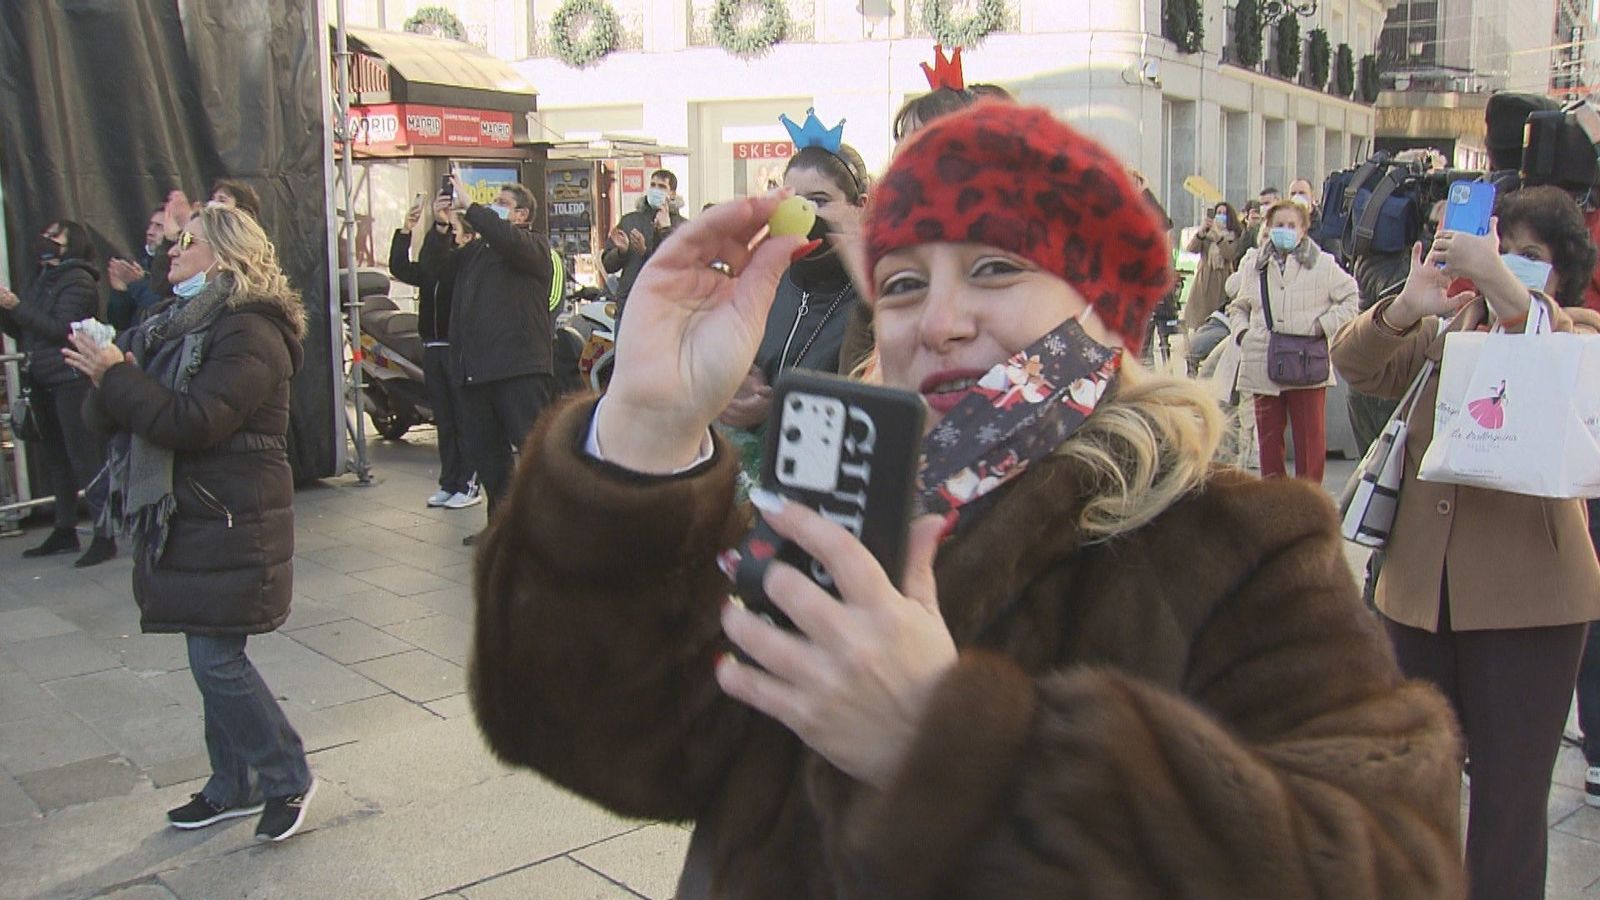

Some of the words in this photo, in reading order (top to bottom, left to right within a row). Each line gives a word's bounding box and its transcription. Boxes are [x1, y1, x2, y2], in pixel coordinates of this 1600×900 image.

[348, 116, 397, 132] ADRID
[407, 114, 440, 132] MADRID
[481, 121, 510, 136] MADRID
[739, 142, 794, 158] SKEC
[553, 203, 585, 215] TOLEDO
